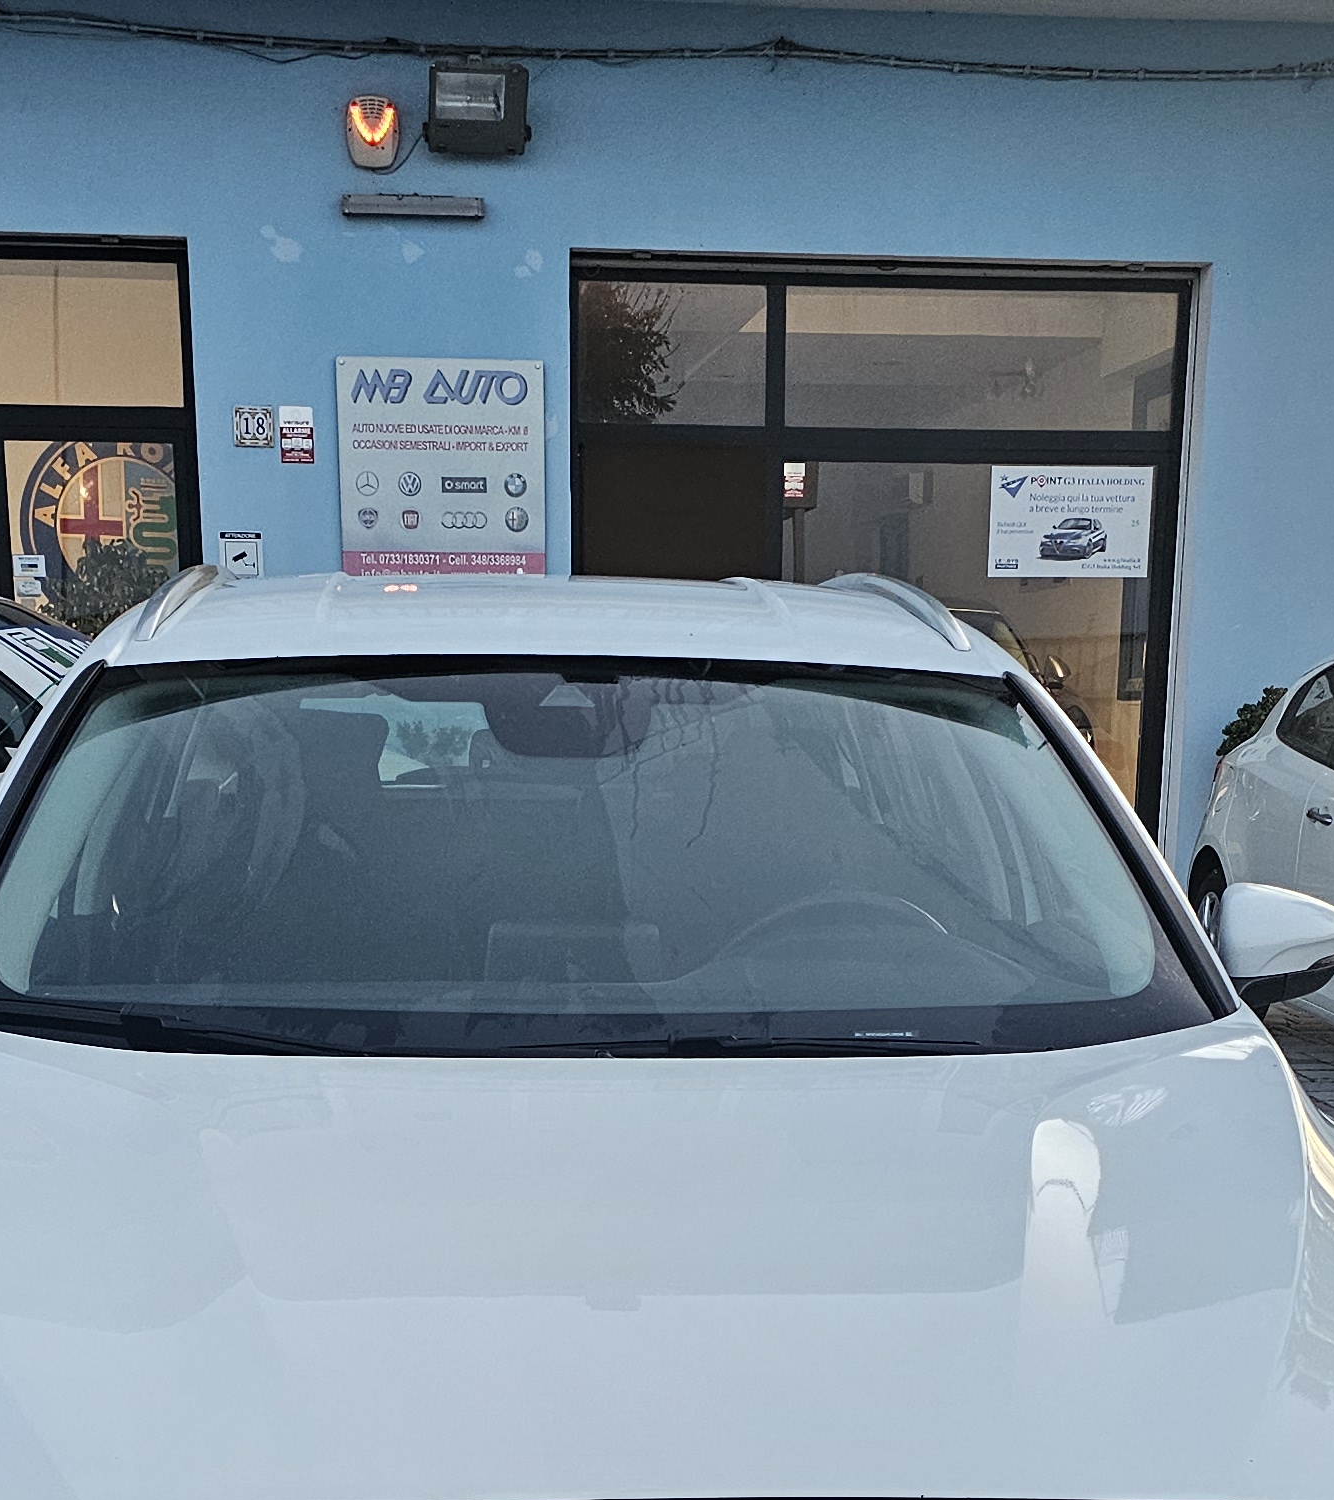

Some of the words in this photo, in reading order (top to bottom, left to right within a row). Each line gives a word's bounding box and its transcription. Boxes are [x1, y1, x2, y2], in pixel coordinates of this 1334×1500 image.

[351, 369, 413, 404] MB
[423, 369, 528, 405] AUTO
[243, 416, 266, 436] 18
[352, 423, 375, 434] AUTO
[376, 423, 405, 434] NUOVE
[406, 424, 417, 434] ED
[418, 424, 444, 434] USATE
[445, 424, 453, 435] DI
[453, 425, 474, 435] OGNI
[474, 425, 505, 436] MARCA
[352, 439, 398, 450] OCCASIONI
[399, 440, 451, 451] SEMESTRALI
[456, 441, 487, 451] IMPORT
[488, 442, 495, 452] &
[495, 442, 529, 452] EXPORT
[455, 478, 485, 491] smart
[1030, 475, 1063, 488] POINT
[1063, 477, 1076, 486] G3
[1077, 477, 1105, 486] ITALIA
[1107, 478, 1145, 486] HOLDING
[1029, 493, 1066, 504] Noleggia
[1067, 494, 1081, 505] qui
[1081, 494, 1090, 502] la
[1104, 495, 1136, 503] vettura
[1035, 504, 1059, 513] breve
[1067, 504, 1090, 515] lungo
[1091, 505, 1124, 513] termine
[360, 553, 378, 565] Tel.
[379, 553, 440, 565] 0733/1830371
[448, 554, 469, 565] Cell.
